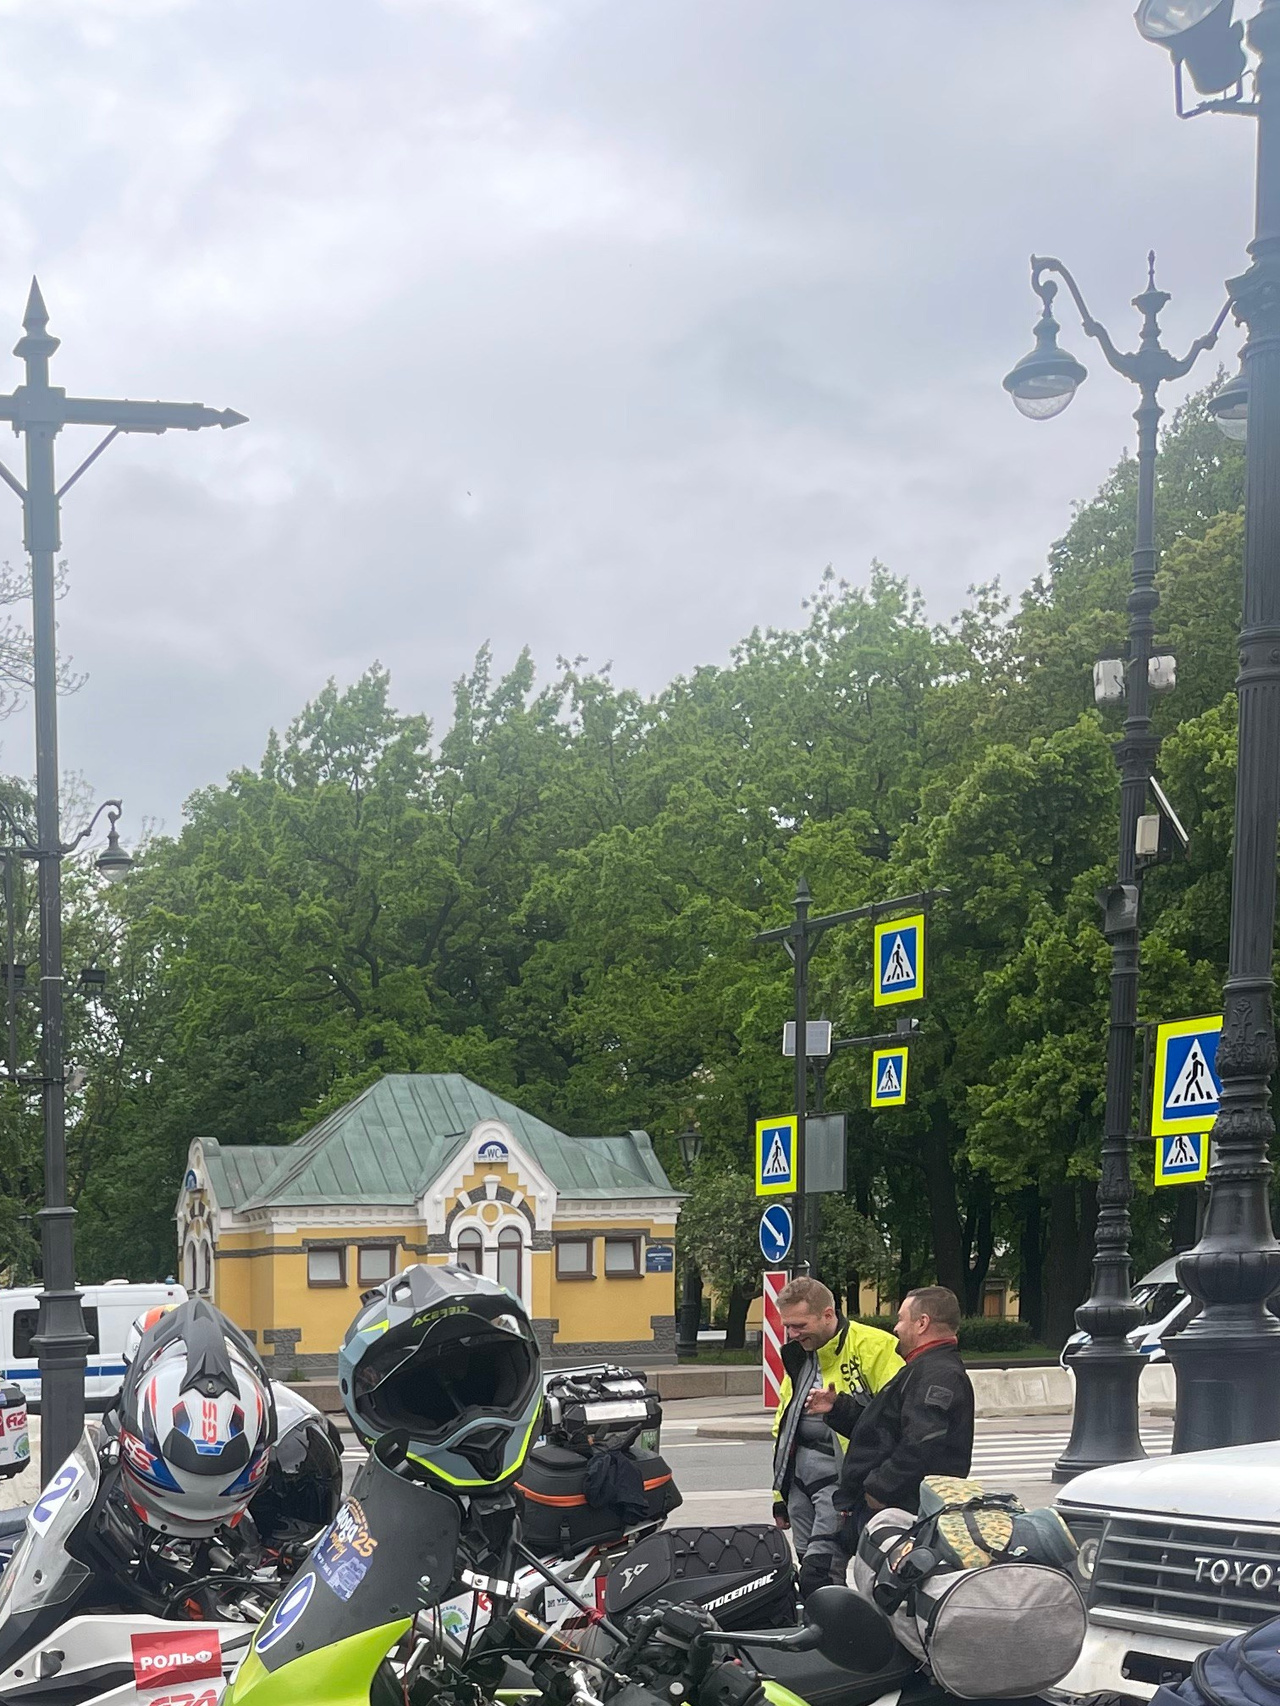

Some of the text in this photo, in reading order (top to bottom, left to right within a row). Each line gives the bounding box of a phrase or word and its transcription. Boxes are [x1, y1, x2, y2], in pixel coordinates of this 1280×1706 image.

[33, 1467, 78, 1522] 2
[1195, 1557, 1280, 1592] TOYO
[255, 1572, 316, 1653] 9
[140, 1651, 213, 1671] РОЛЬФ
